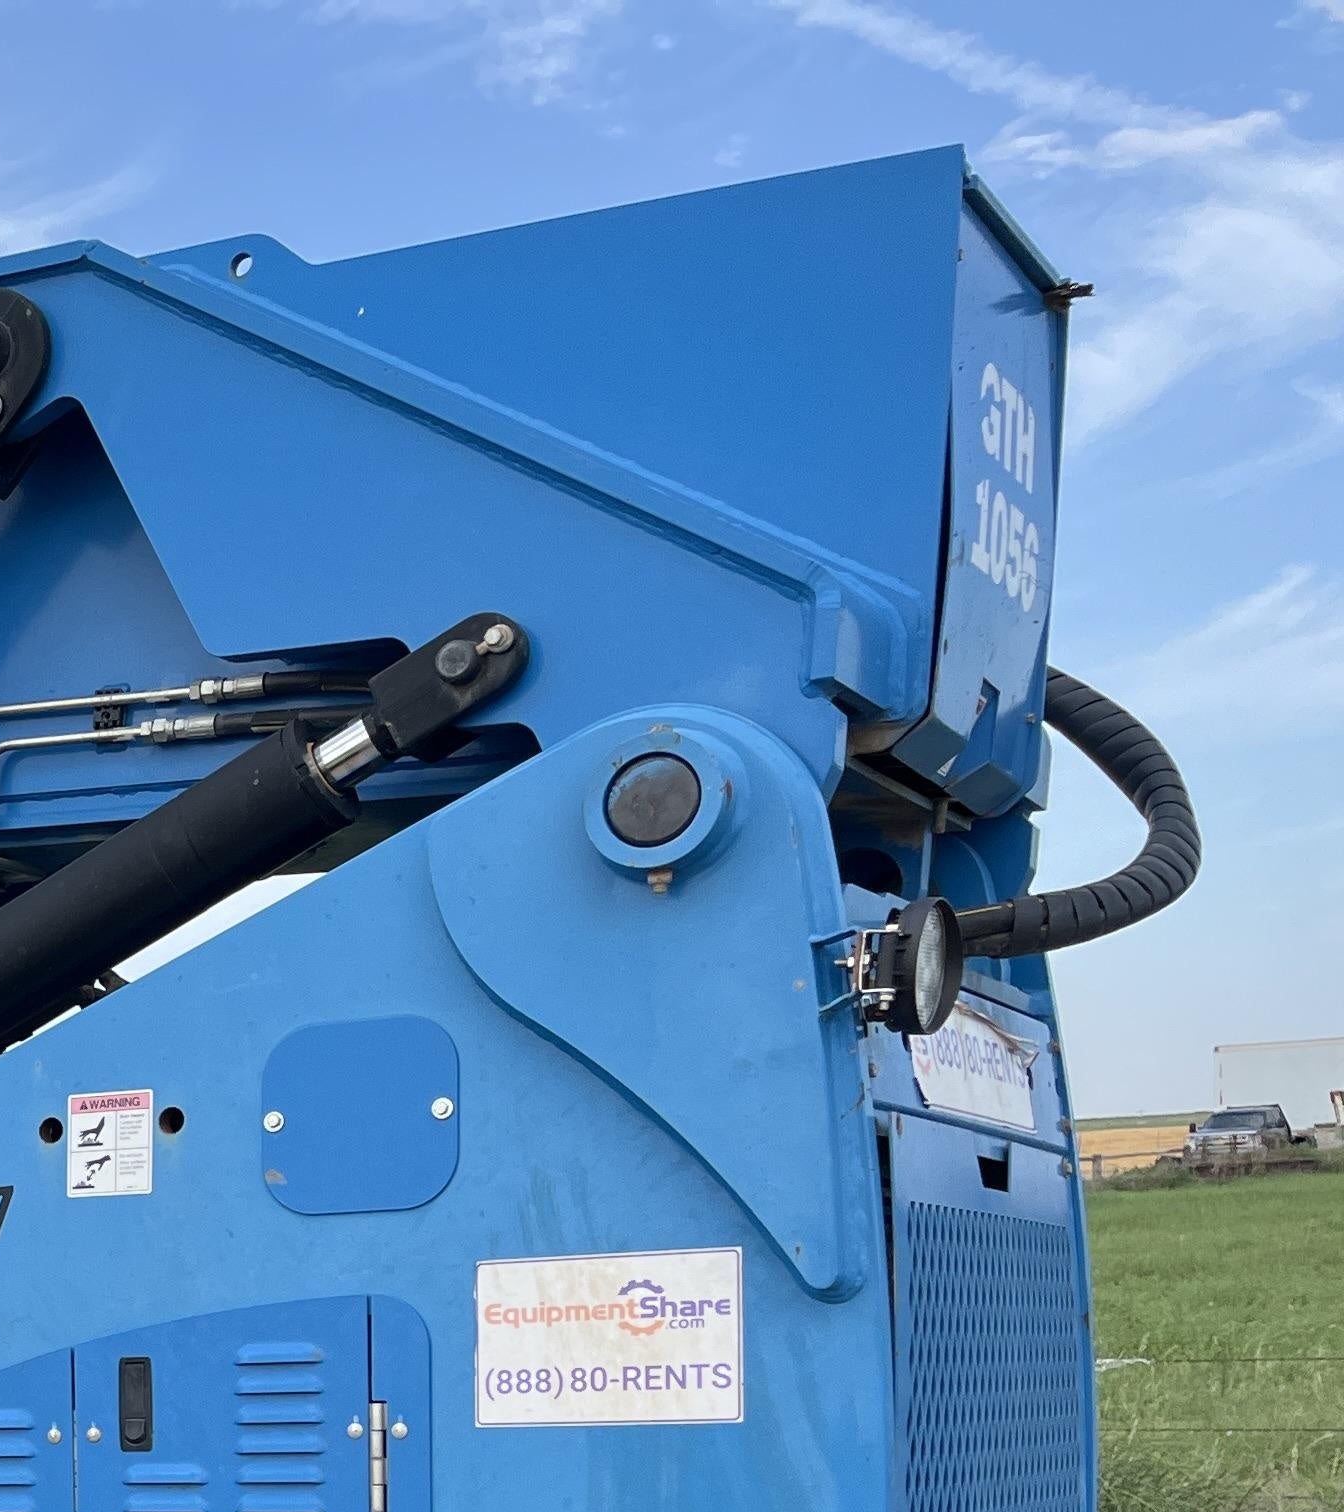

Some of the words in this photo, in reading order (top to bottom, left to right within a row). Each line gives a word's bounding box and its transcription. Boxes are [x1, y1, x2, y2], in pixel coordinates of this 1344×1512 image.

[980, 362, 1036, 494] GTH
[971, 479, 1039, 612] 1056
[89, 1097, 141, 1110] WARNING
[484, 1296, 731, 1329] EquipmentShare
[665, 1317, 705, 1330] .com
